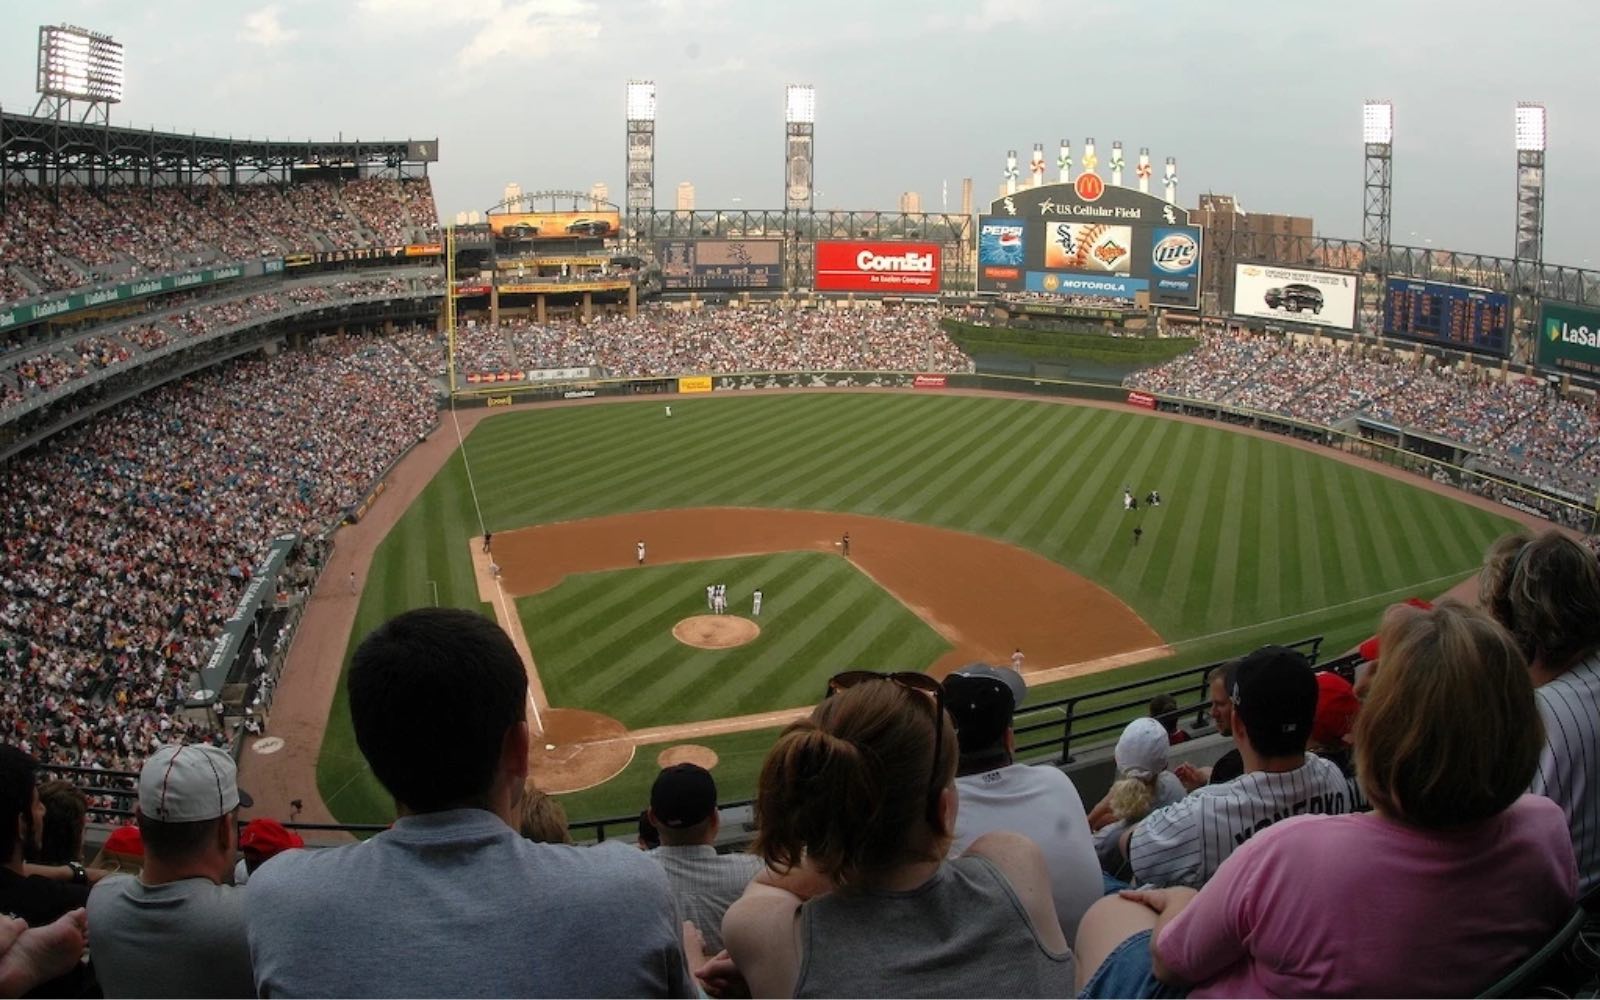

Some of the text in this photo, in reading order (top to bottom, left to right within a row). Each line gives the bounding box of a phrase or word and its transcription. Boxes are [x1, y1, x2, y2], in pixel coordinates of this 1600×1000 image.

[1073, 205, 1114, 217] Cellular
[1115, 207, 1141, 219] Field
[982, 225, 1024, 237] PEPSI
[856, 249, 933, 271] ComEd
[1159, 244, 1195, 262] Lite
[1063, 279, 1126, 292] MOTOROLA
